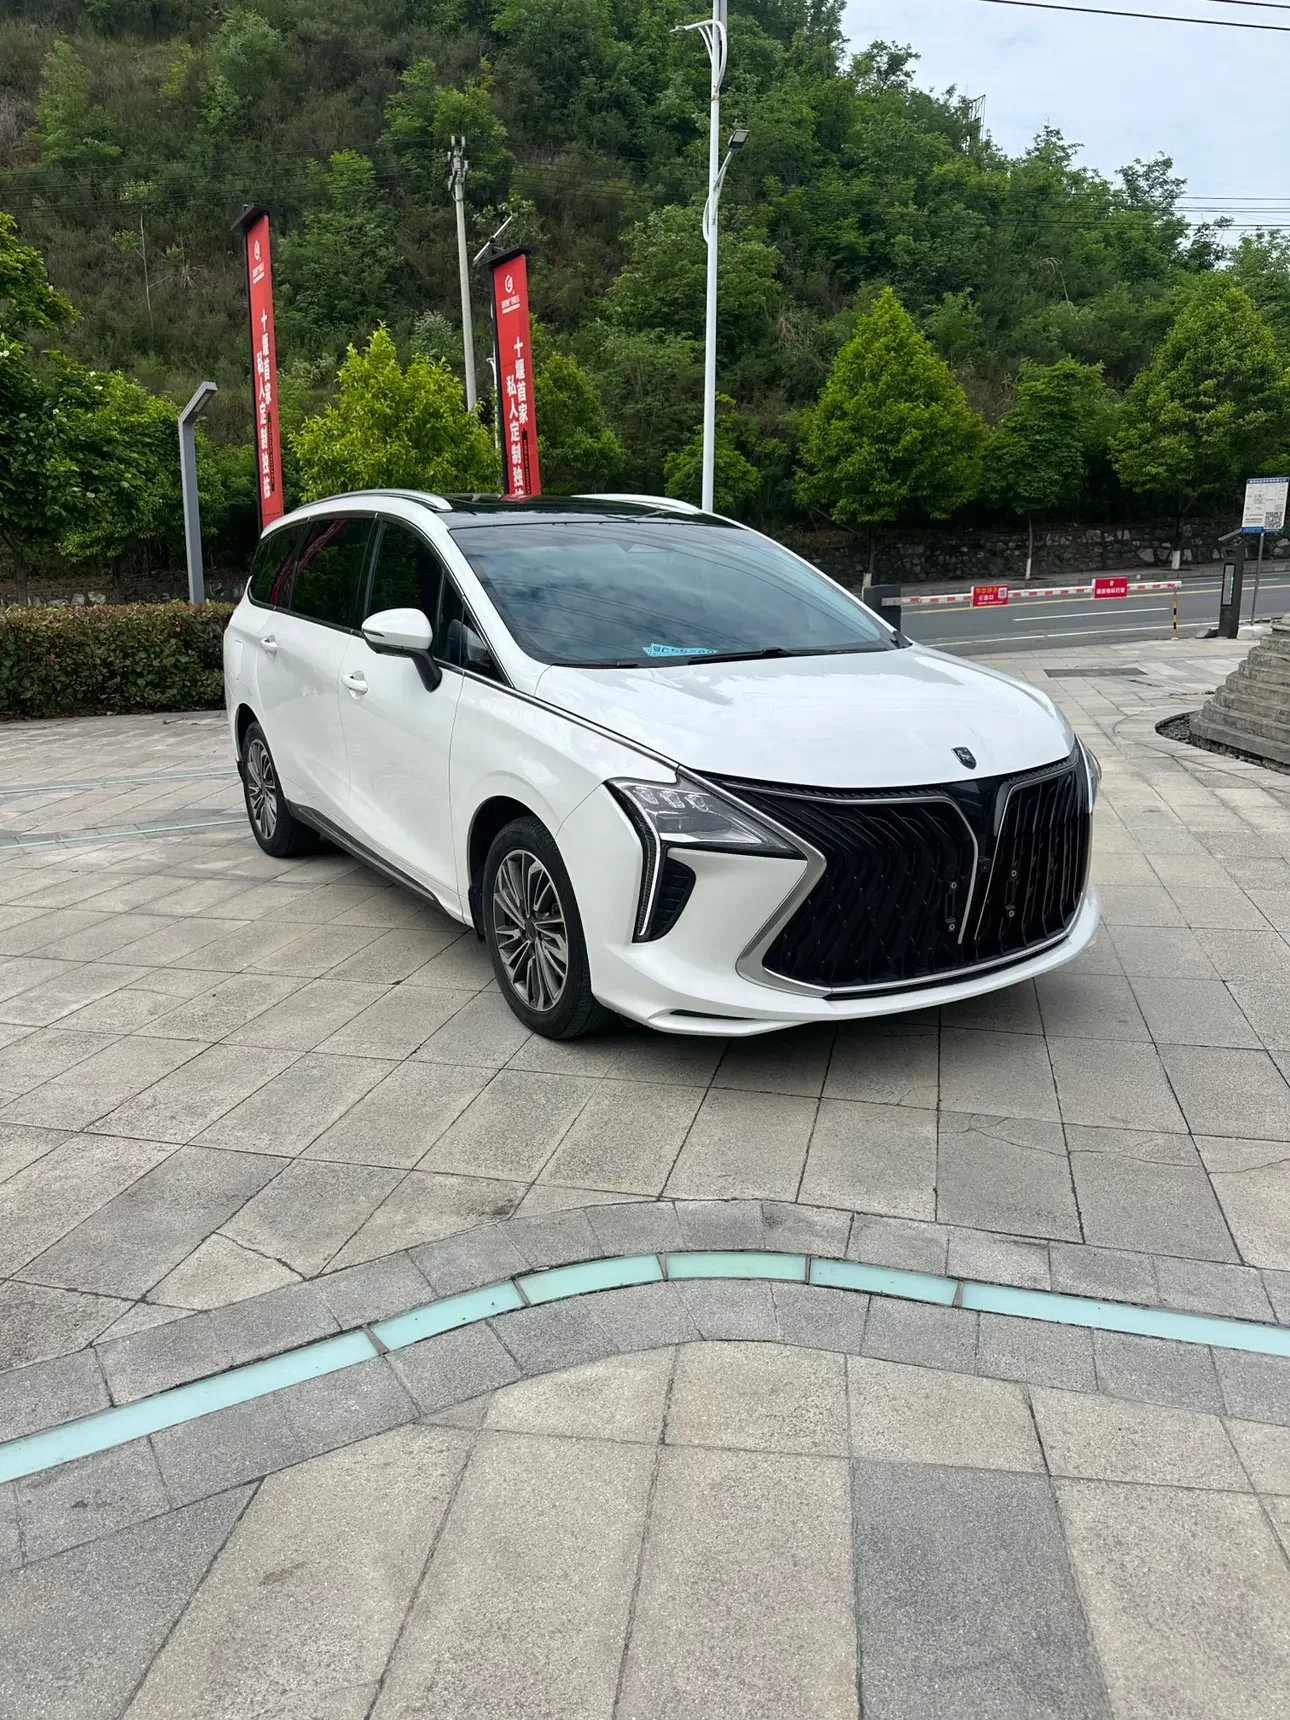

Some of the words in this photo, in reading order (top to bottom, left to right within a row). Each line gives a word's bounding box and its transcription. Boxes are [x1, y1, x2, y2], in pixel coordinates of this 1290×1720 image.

[261, 308, 272, 405] 十堰首家
[513, 336, 529, 425] 十堰首家
